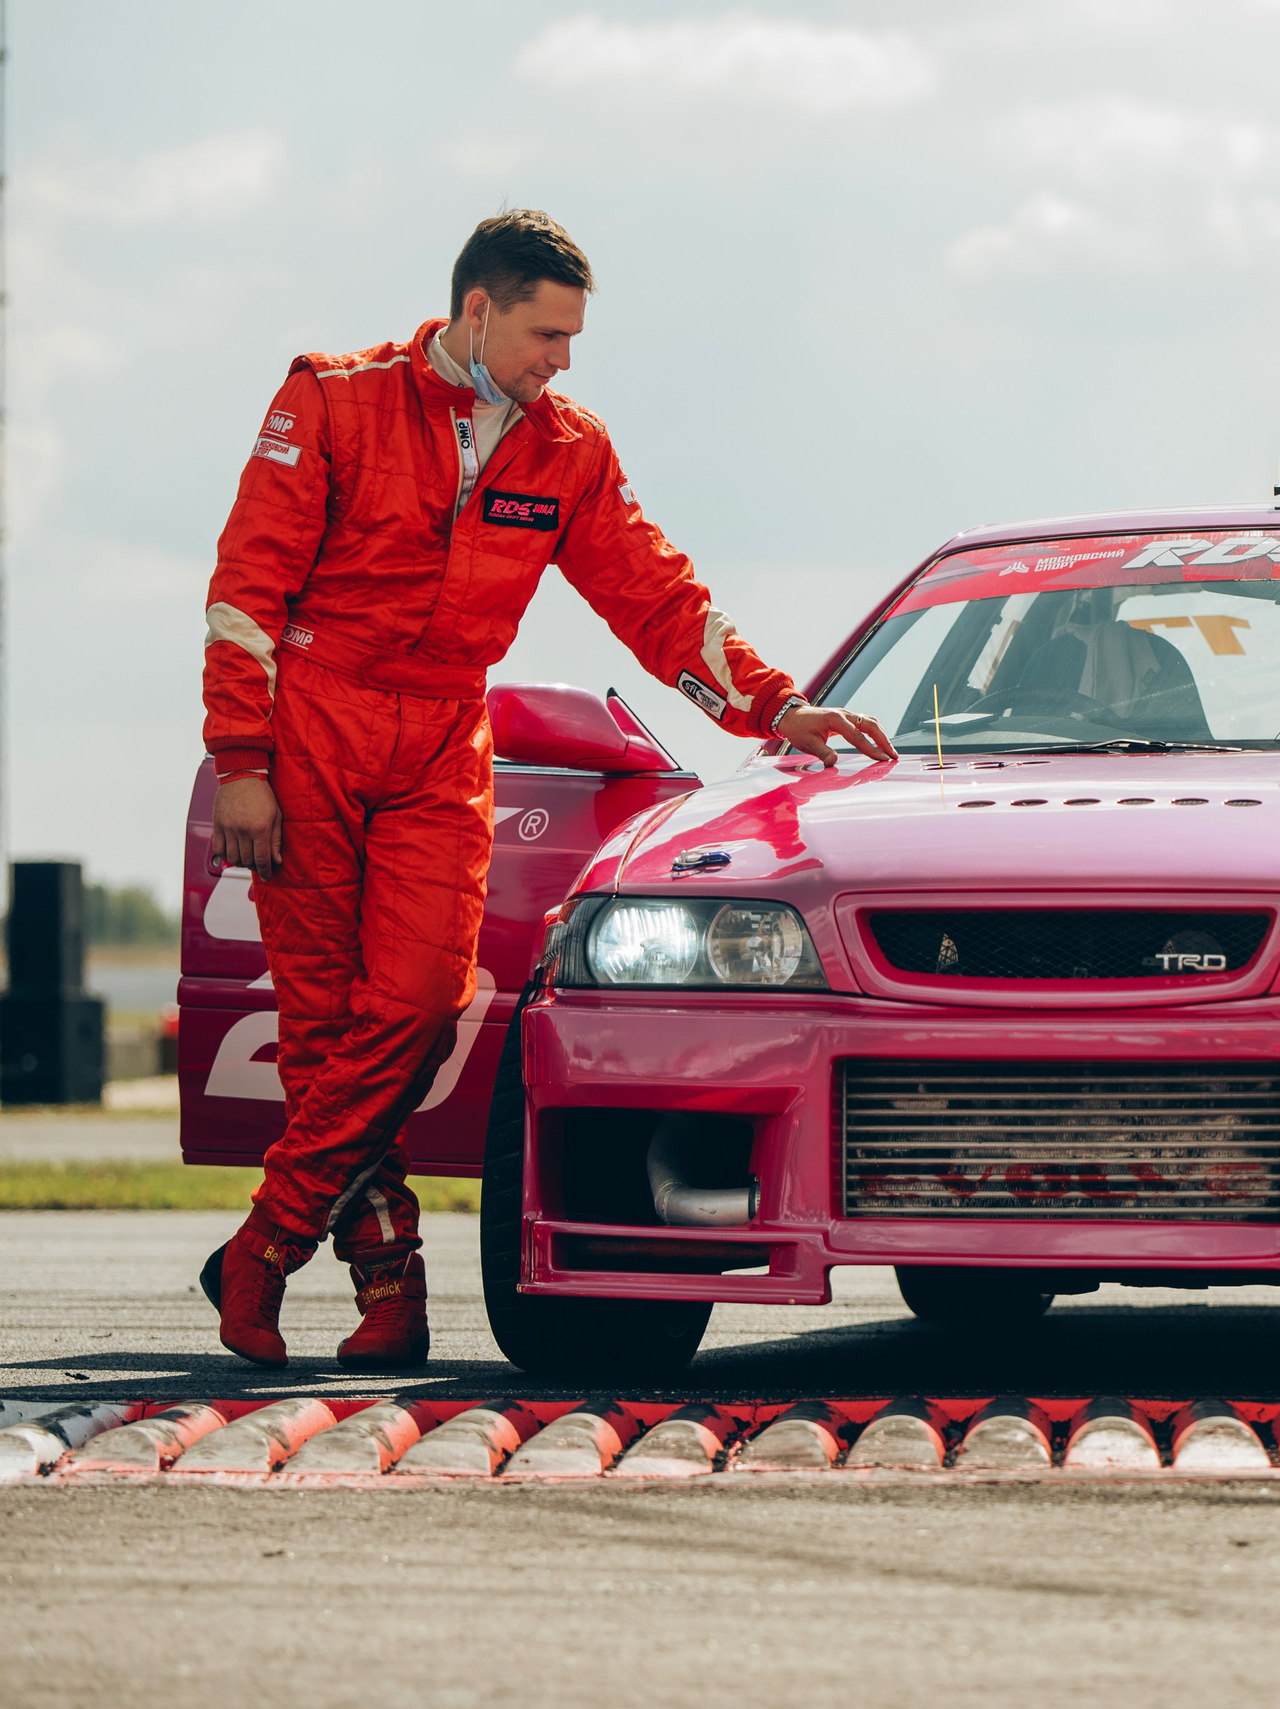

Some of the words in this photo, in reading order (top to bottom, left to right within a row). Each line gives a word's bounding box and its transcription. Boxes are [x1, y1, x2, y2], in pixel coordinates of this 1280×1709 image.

[266, 415, 294, 433] OMP
[458, 421, 471, 449] OMP
[490, 498, 534, 516] RDS
[1036, 548, 1125, 565] МОСКОВСКИЙ
[1034, 560, 1077, 572] СПОРТ
[282, 627, 314, 646] OMP
[1155, 953, 1227, 971] TRD
